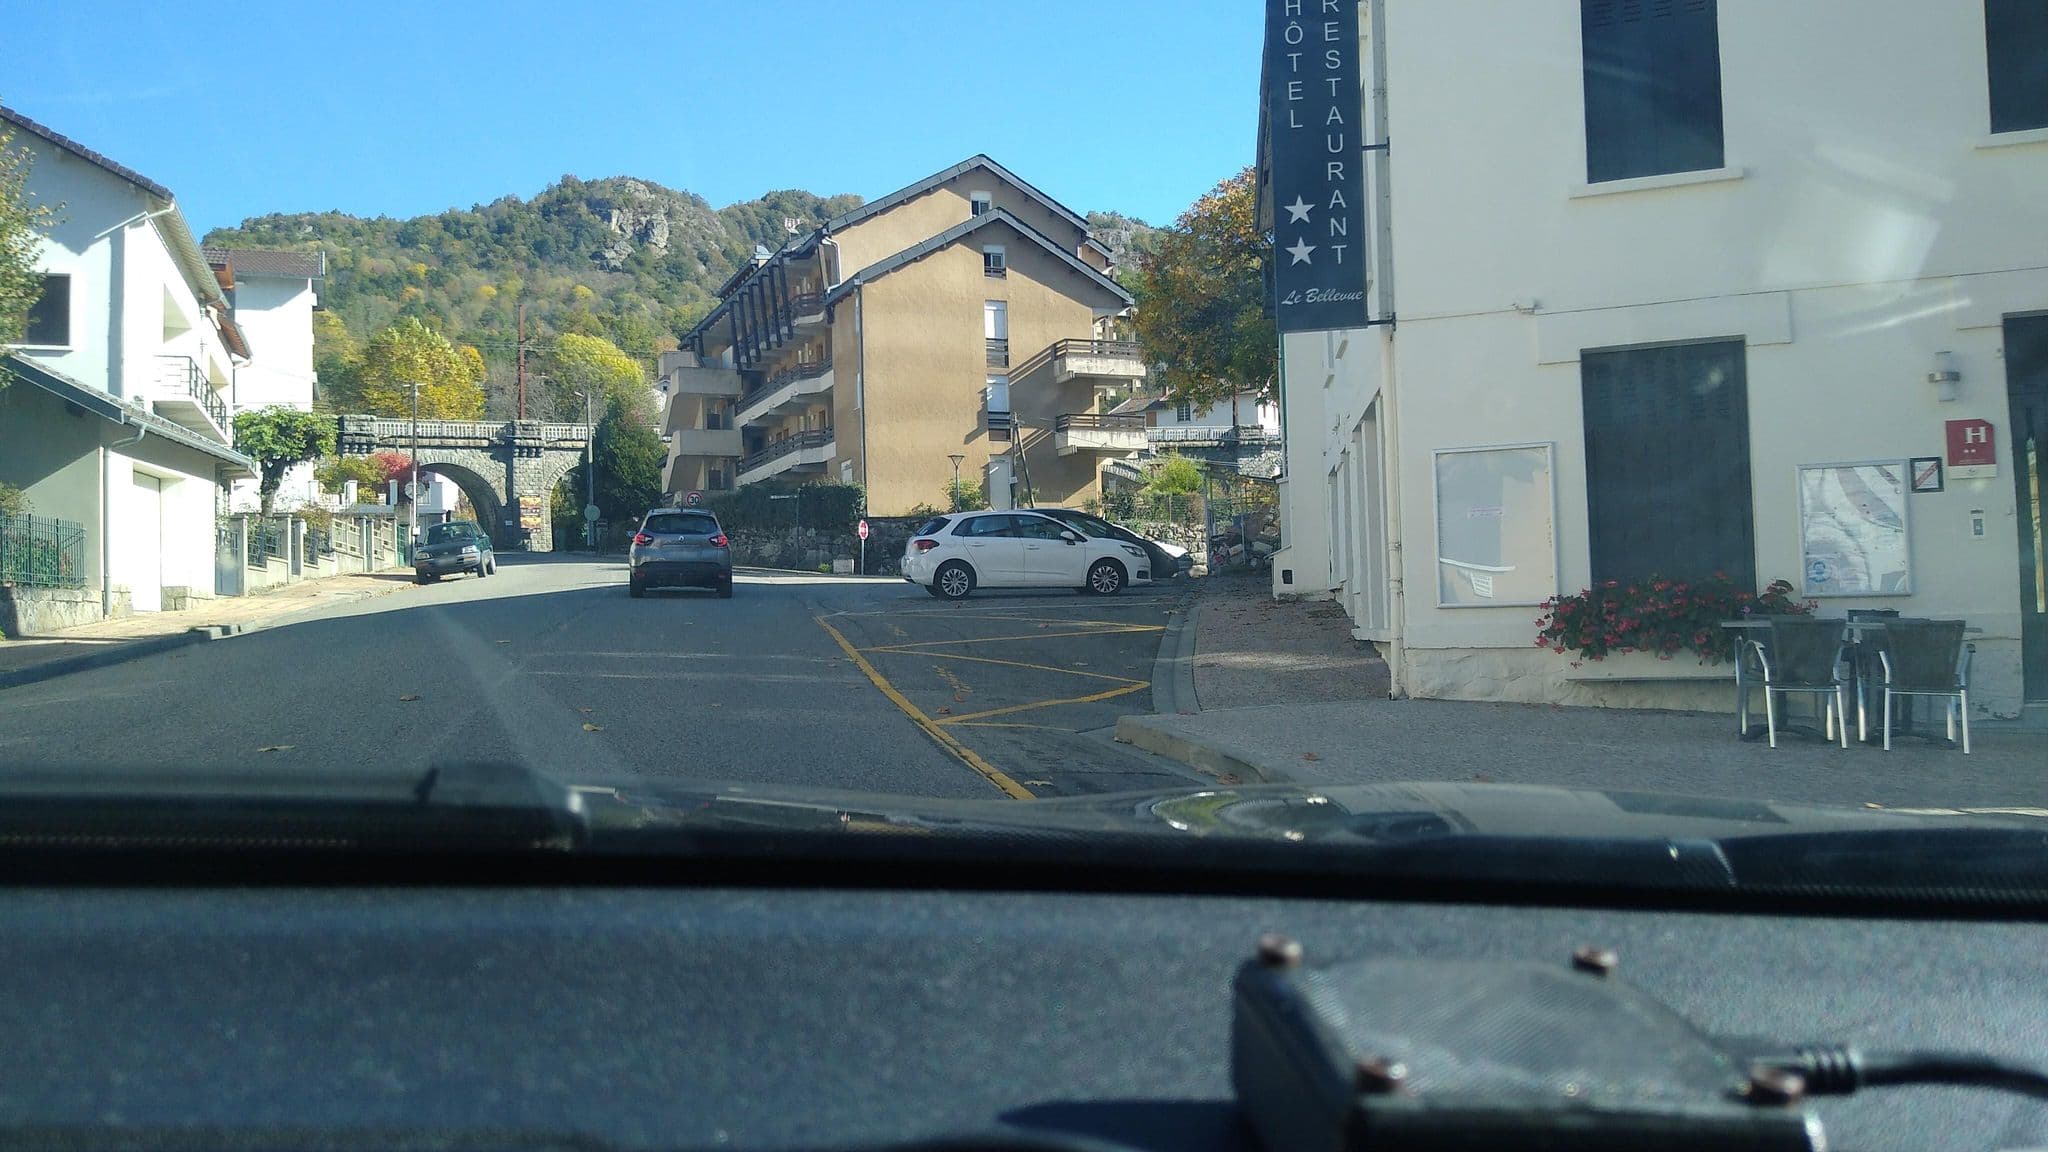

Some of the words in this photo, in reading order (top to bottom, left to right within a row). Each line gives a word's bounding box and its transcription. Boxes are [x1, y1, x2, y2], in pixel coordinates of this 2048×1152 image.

[1284, 0, 1304, 128] HÔTEL
[1322, 0, 1347, 265] RESTAURANT
[1281, 290, 1302, 305] Le
[1305, 288, 1364, 303] Bellevue
[1964, 426, 1987, 444] H
[689, 496, 700, 504] 30
